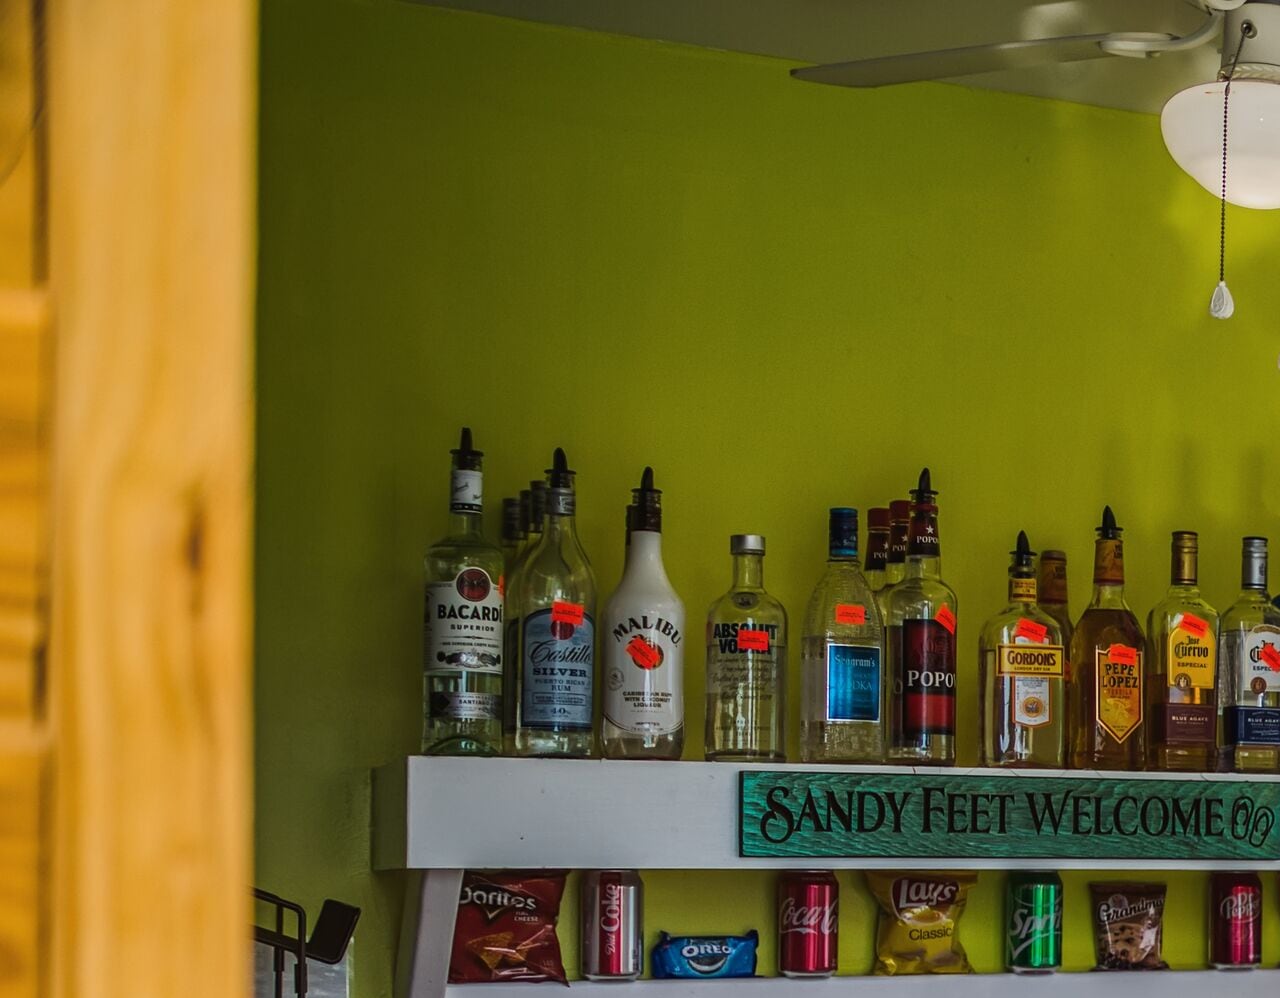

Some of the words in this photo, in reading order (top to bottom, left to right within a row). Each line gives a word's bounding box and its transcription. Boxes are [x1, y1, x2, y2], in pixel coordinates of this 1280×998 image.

[917, 536, 938, 544] POPO
[450, 624, 495, 632] SUPERIOR
[612, 615, 681, 644] MALIBU
[1174, 641, 1209, 659] Cuervo
[533, 668, 587, 677] SILVER
[1104, 663, 1135, 676] PEPE
[907, 669, 956, 688] POPO
[1102, 675, 1138, 689] LOPEZ
[760, 785, 911, 845] SANDY
[919, 786, 1015, 835] FEET
[1024, 789, 1226, 838] WELCOME
[600, 883, 621, 933] Coke
[1009, 908, 1062, 940] Sprit
[908, 928, 952, 942] Classic
[681, 945, 733, 958] OREO
